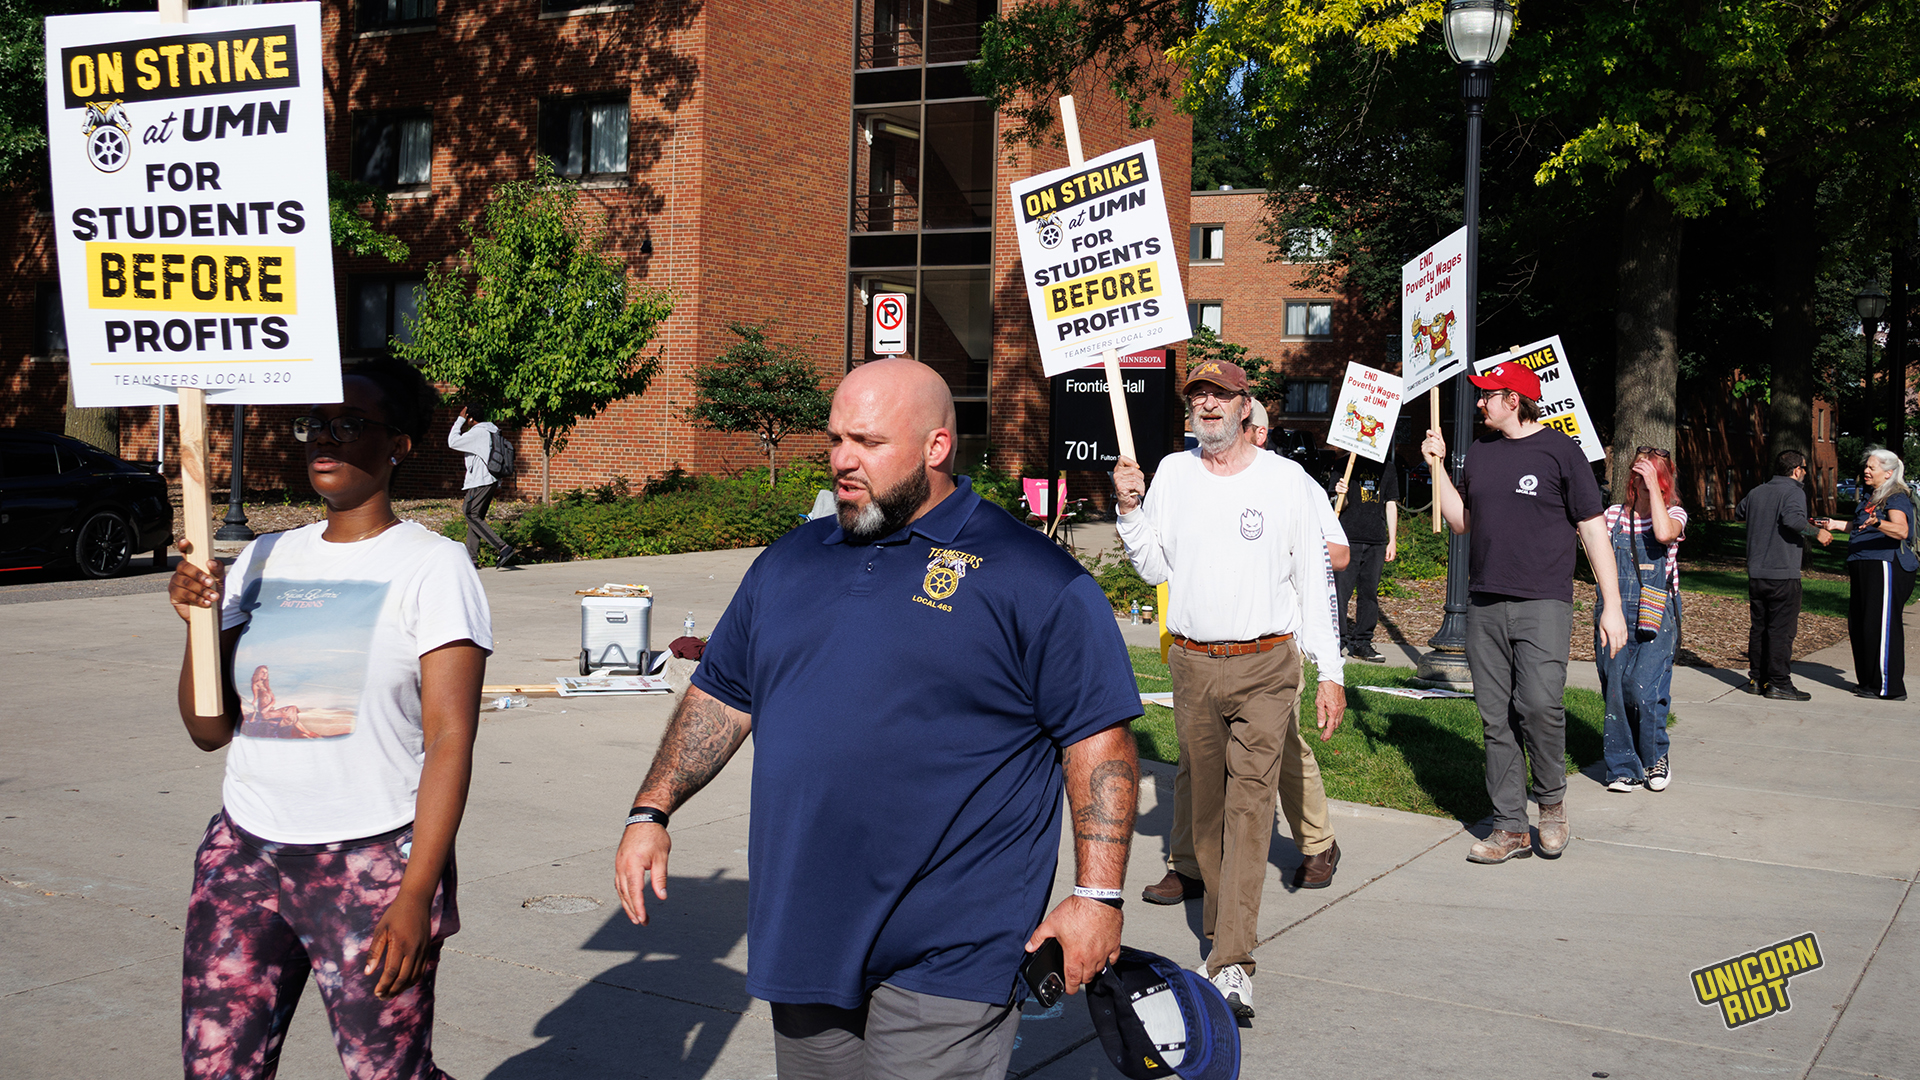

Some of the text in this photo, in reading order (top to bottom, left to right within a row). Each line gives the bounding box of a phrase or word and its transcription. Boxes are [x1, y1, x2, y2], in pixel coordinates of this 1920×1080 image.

[70, 35, 290, 98] ON STRIKE
[143, 99, 291, 145] at UMN
[145, 161, 222, 193] FOR
[1026, 157, 1144, 217] ON STRIKE
[72, 200, 306, 242] STUDENTS
[1069, 188, 1146, 230] at UMN
[1071, 228, 1114, 253] FOR
[1034, 237, 1162, 287] STUDENTS
[1405, 253, 1462, 297] Poverty Wages
[1419, 251, 1434, 272] END
[101, 252, 283, 303] BEFORE
[1051, 267, 1154, 313] BEFORE
[1425, 275, 1451, 303] at UMN
[1057, 298, 1160, 342] PROFITS
[105, 316, 290, 353] PROFITS
[1064, 326, 1164, 359] TEAMSTERS LOCAL 320
[1513, 347, 1555, 370] RIKE
[114, 372, 292, 387] TEAMSTERS LOCAL 320
[1066, 379, 1110, 393] Frontie
[1347, 376, 1401, 401] Poverty Wages
[1363, 370, 1378, 382] END
[1537, 367, 1560, 383] MN
[1363, 395, 1388, 408] at UMN
[1540, 398, 1575, 418] ENTS
[1065, 441, 1098, 460] 701
[928, 547, 983, 569] TEAMSTERS
[912, 595, 953, 613] LOCAL 463
